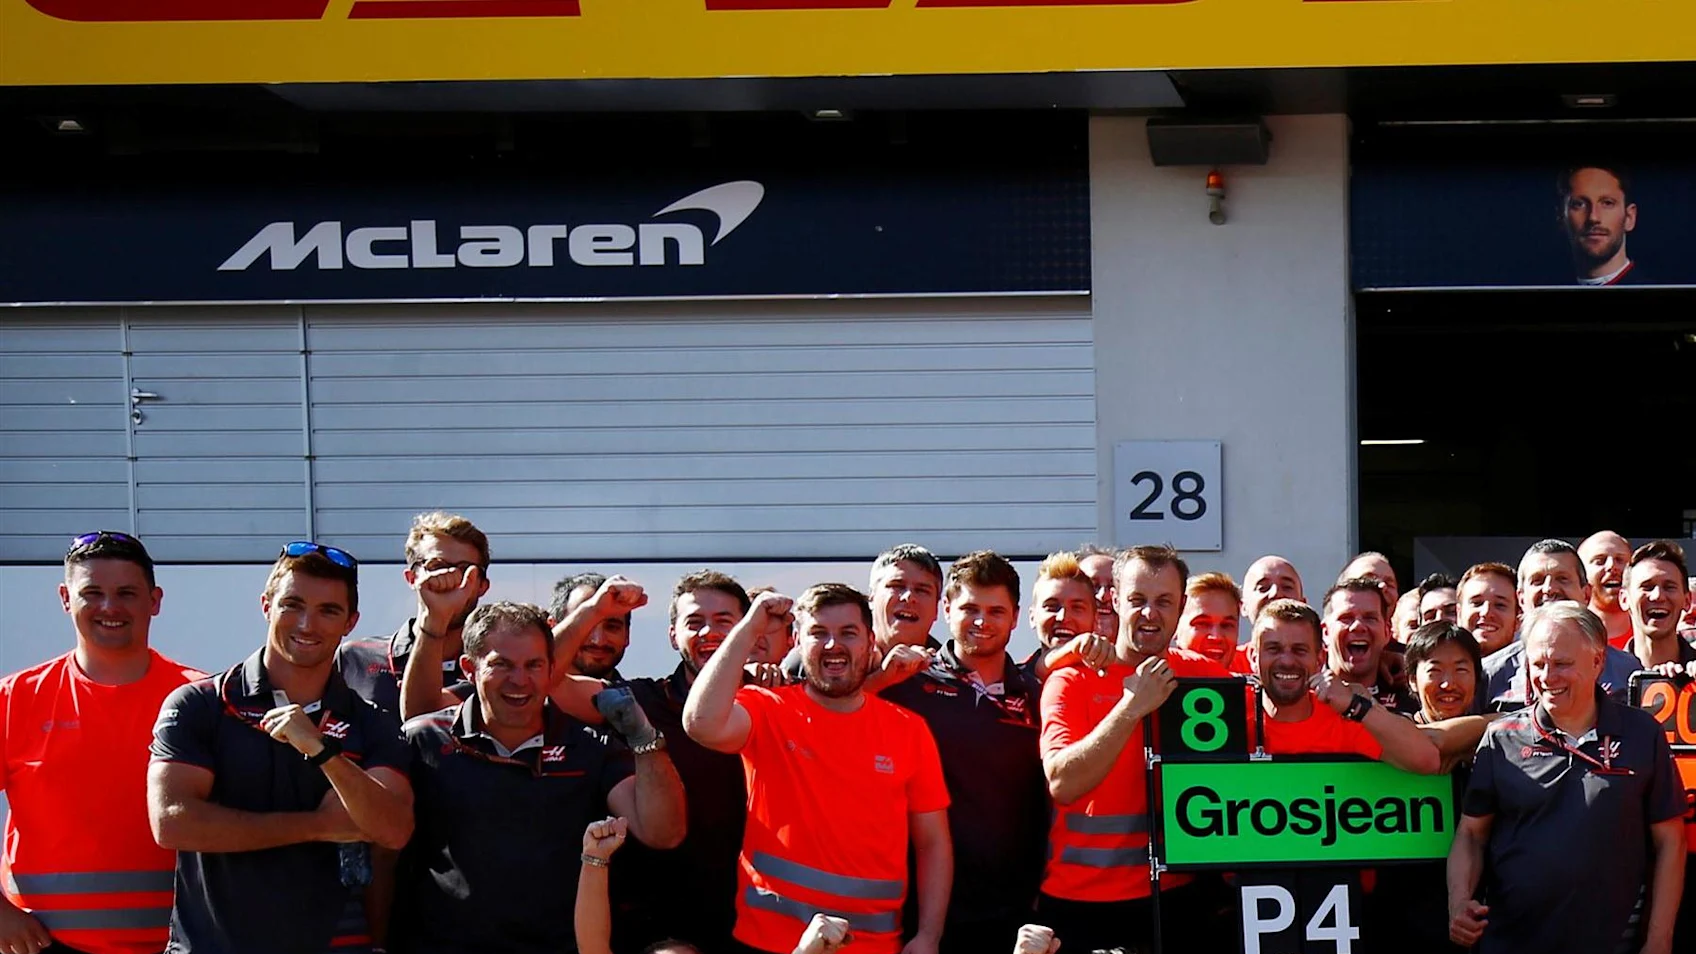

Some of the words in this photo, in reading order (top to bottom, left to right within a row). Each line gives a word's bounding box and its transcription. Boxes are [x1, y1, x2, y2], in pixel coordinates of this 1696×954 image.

[216, 219, 706, 271] McLaren
[1129, 470, 1207, 521] 28
[1181, 687, 1229, 752] 8
[1175, 785, 1444, 847] Grosjean
